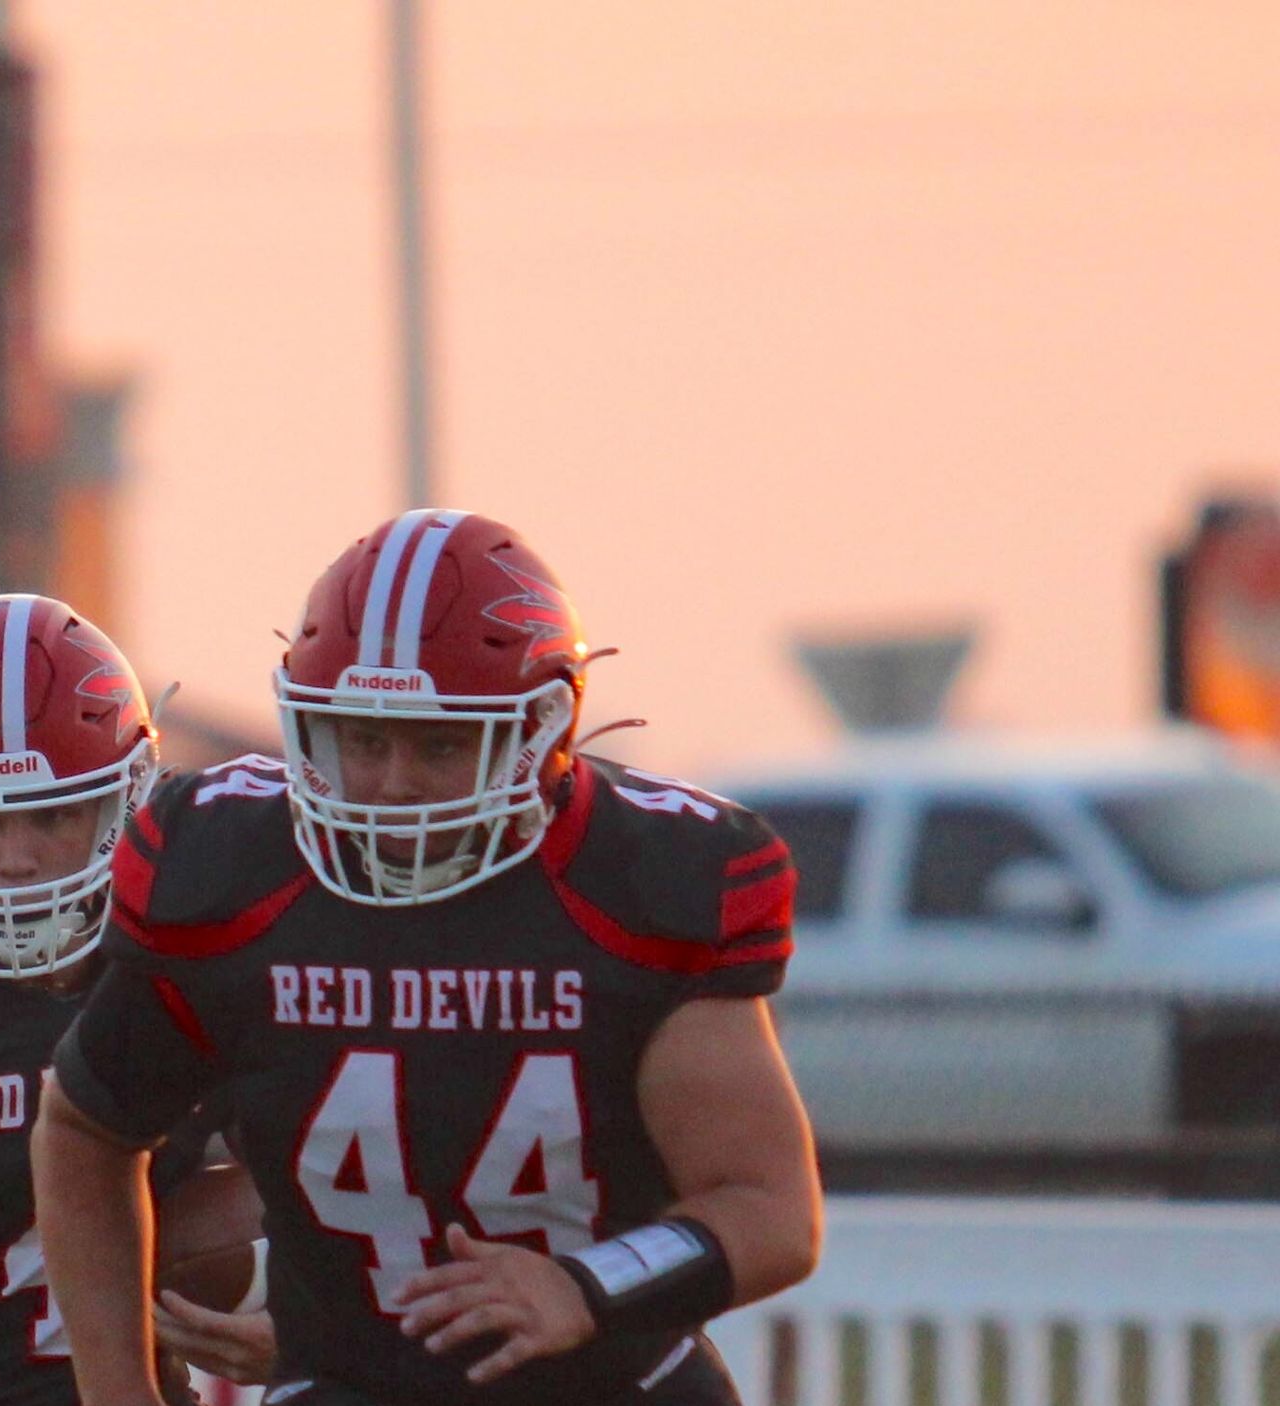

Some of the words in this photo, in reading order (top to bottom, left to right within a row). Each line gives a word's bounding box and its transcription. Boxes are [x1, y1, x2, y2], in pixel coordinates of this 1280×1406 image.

[270, 964, 373, 1028] RED
[391, 969, 584, 1031] DEVILS
[296, 1050, 601, 1318] 44
